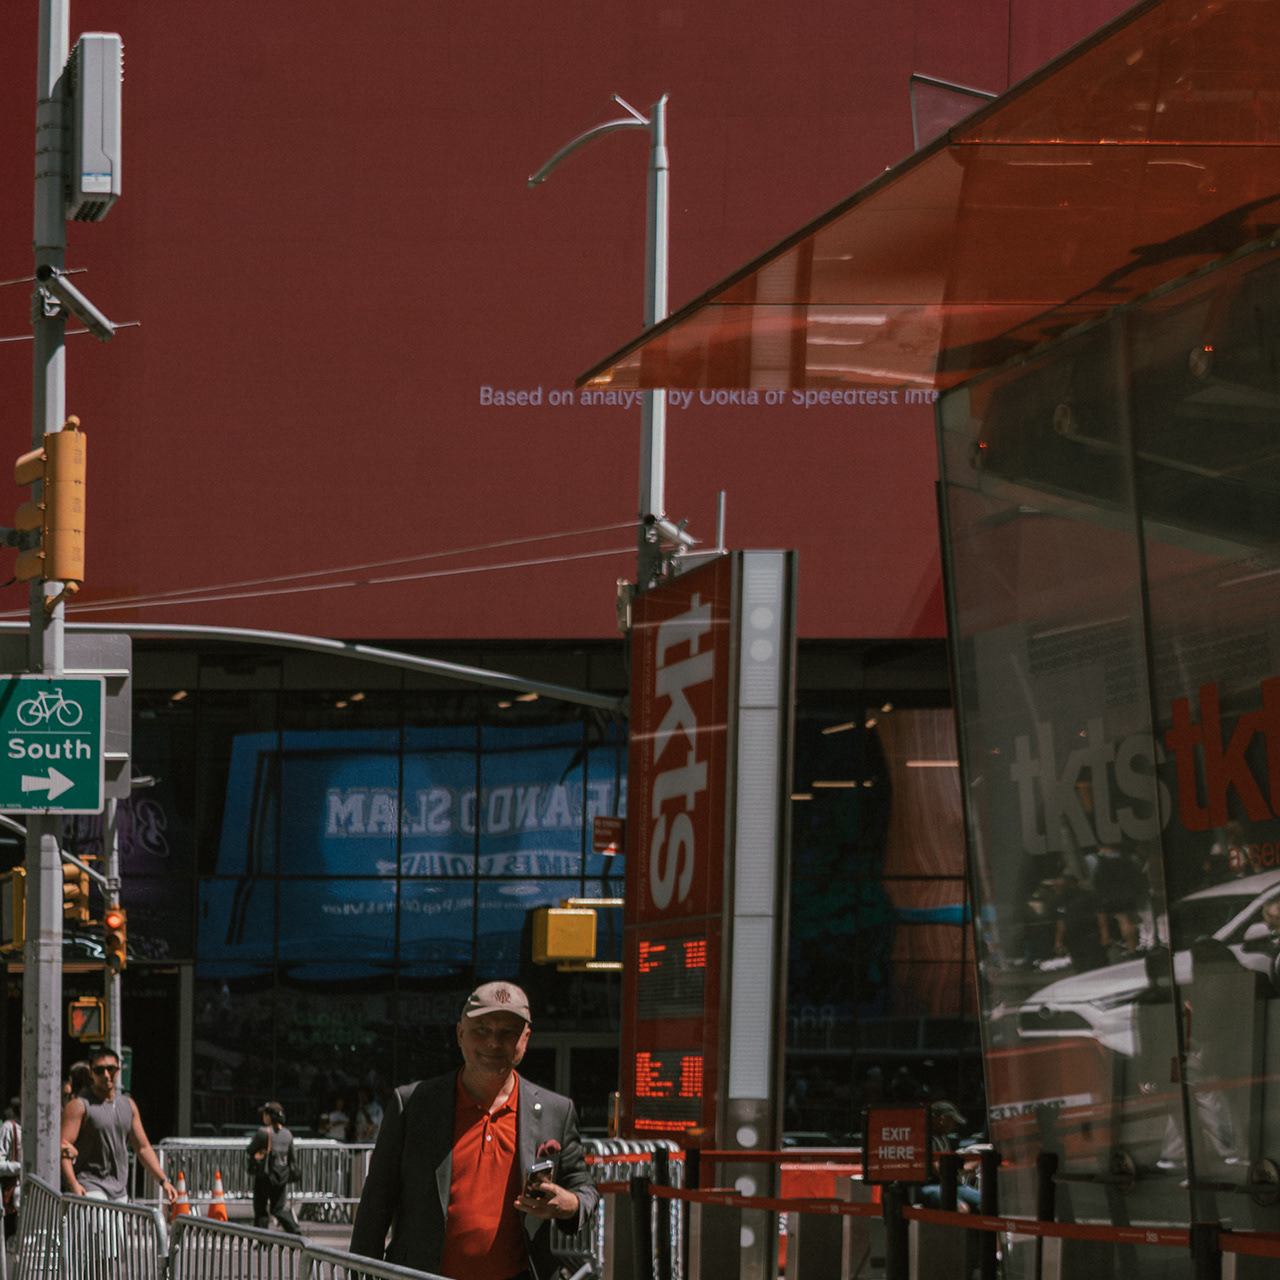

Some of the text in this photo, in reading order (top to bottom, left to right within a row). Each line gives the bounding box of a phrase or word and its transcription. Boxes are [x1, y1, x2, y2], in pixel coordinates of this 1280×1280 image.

[479, 386, 542, 407] Based
[549, 391, 574, 407] on
[668, 389, 690, 409] by
[699, 390, 759, 407] Ookla
[764, 390, 786, 406] of
[792, 390, 897, 410] Speedtest
[8, 738, 91, 759] South
[650, 593, 715, 911] tkts
[1010, 719, 1172, 855] tkts
[882, 1127, 911, 1141] EXIT
[878, 1145, 915, 1160] HERE
